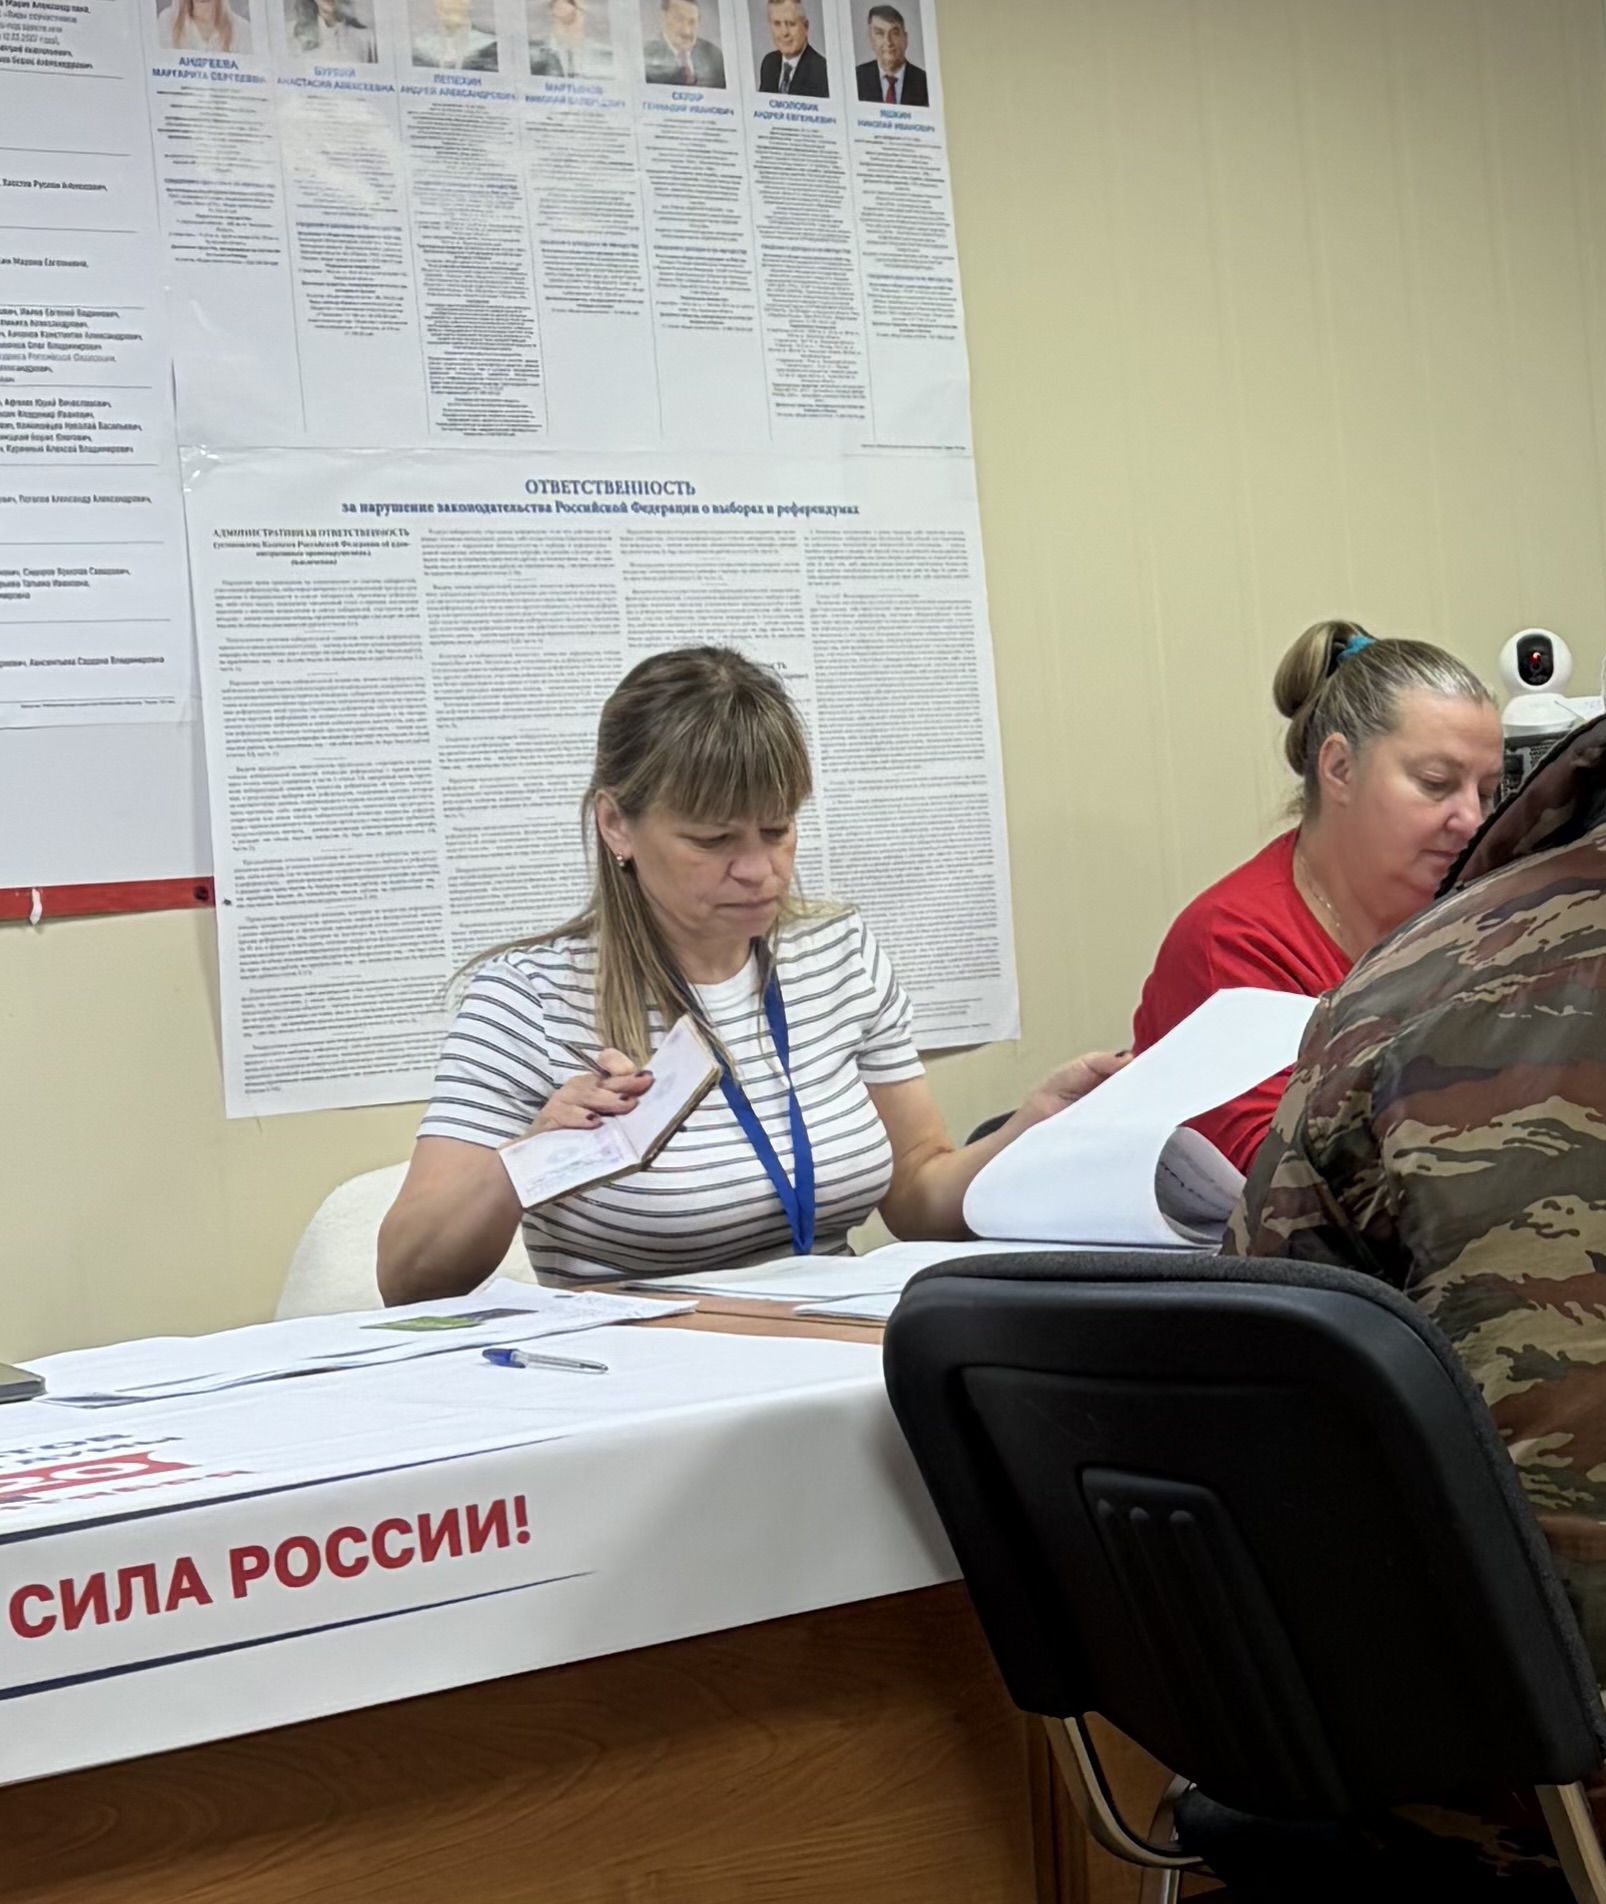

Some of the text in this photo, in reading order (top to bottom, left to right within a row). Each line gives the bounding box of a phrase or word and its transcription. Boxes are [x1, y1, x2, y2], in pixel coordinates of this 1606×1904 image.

[524, 478, 697, 497] ОТВЕТСТВЕННОСТЬ
[341, 500, 860, 517] за нарушение законодательства Российской Федерации о выборах и референдумах
[318, 528, 410, 538] ОТВЕТСТВЕННОСТЬ
[0, 1433, 132, 1458] ТОВ
[9, 1494, 532, 1639] СИЛА РОССИИ!
